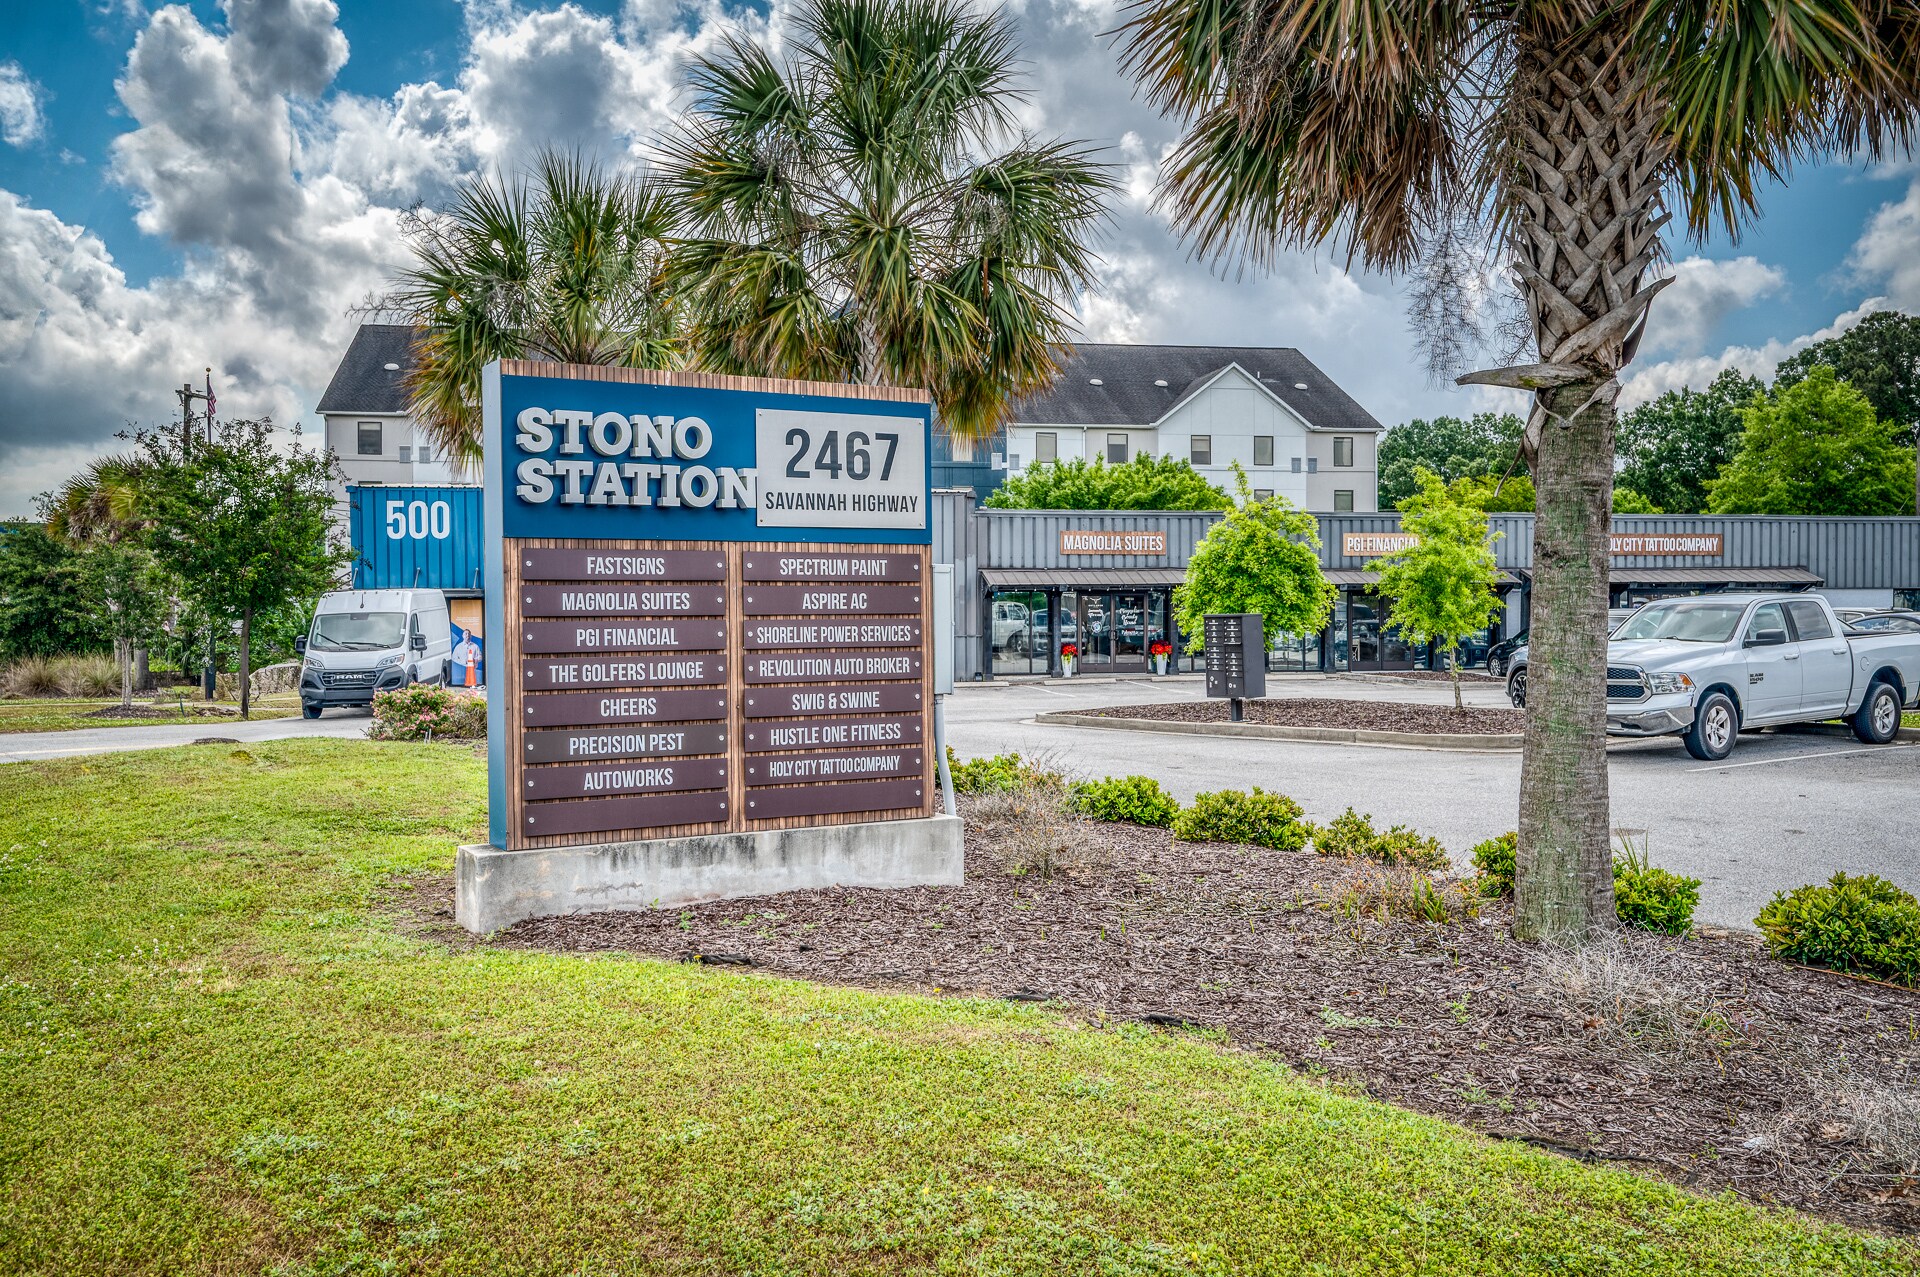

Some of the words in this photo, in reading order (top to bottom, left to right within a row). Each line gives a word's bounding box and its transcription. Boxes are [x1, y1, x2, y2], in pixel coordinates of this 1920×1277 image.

[516, 407, 712, 460] STONO
[785, 428, 899, 481] 2467
[516, 458, 757, 509] STATION
[765, 491, 846, 511] SAVANNAH
[852, 493, 918, 513] HIGHWAY
[386, 500, 450, 540] 500
[1063, 535, 1121, 551] MAGNOLIA
[1124, 536, 1163, 551] SUITES
[1347, 537, 1364, 551] PGI
[1623, 537, 1643, 551] CITY
[1645, 537, 1676, 551] TATTOO
[1676, 537, 1719, 551] COMPANY
[586, 556, 665, 576] FASTSIGNS
[779, 558, 849, 576] SPECTRUM
[851, 559, 888, 576] PAINT
[562, 592, 638, 611] MAGNOLIA
[641, 592, 691, 611] SUITES
[802, 592, 847, 610] ASPIRE
[850, 592, 868, 610] AC
[576, 628, 600, 647] PGI
[603, 627, 679, 647] FINANCIAL
[756, 626, 819, 644] SHORELINE
[820, 625, 859, 643] POWER
[860, 625, 911, 642] SERVICES
[548, 664, 579, 683] THE
[582, 662, 646, 683] GOLFERS
[649, 661, 704, 681] LOUNGE
[759, 658, 832, 677] REVOLUTION
[833, 657, 864, 676] AUTO
[866, 656, 910, 675] BROKER
[600, 697, 657, 717] CHEERS
[791, 692, 825, 711] SWIG
[828, 692, 838, 710] &
[839, 691, 880, 709] SWINE
[569, 734, 647, 756] PRECISION
[649, 732, 685, 752] PEST
[770, 726, 820, 746] HUSTLE
[822, 725, 848, 743] ONE
[851, 722, 901, 742] FITNESS
[769, 760, 794, 778] HOLY
[794, 759, 818, 776] CITY
[818, 757, 854, 775] TATTOO
[853, 755, 900, 773] COMPANY
[583, 767, 674, 791] AUTOWORKS
